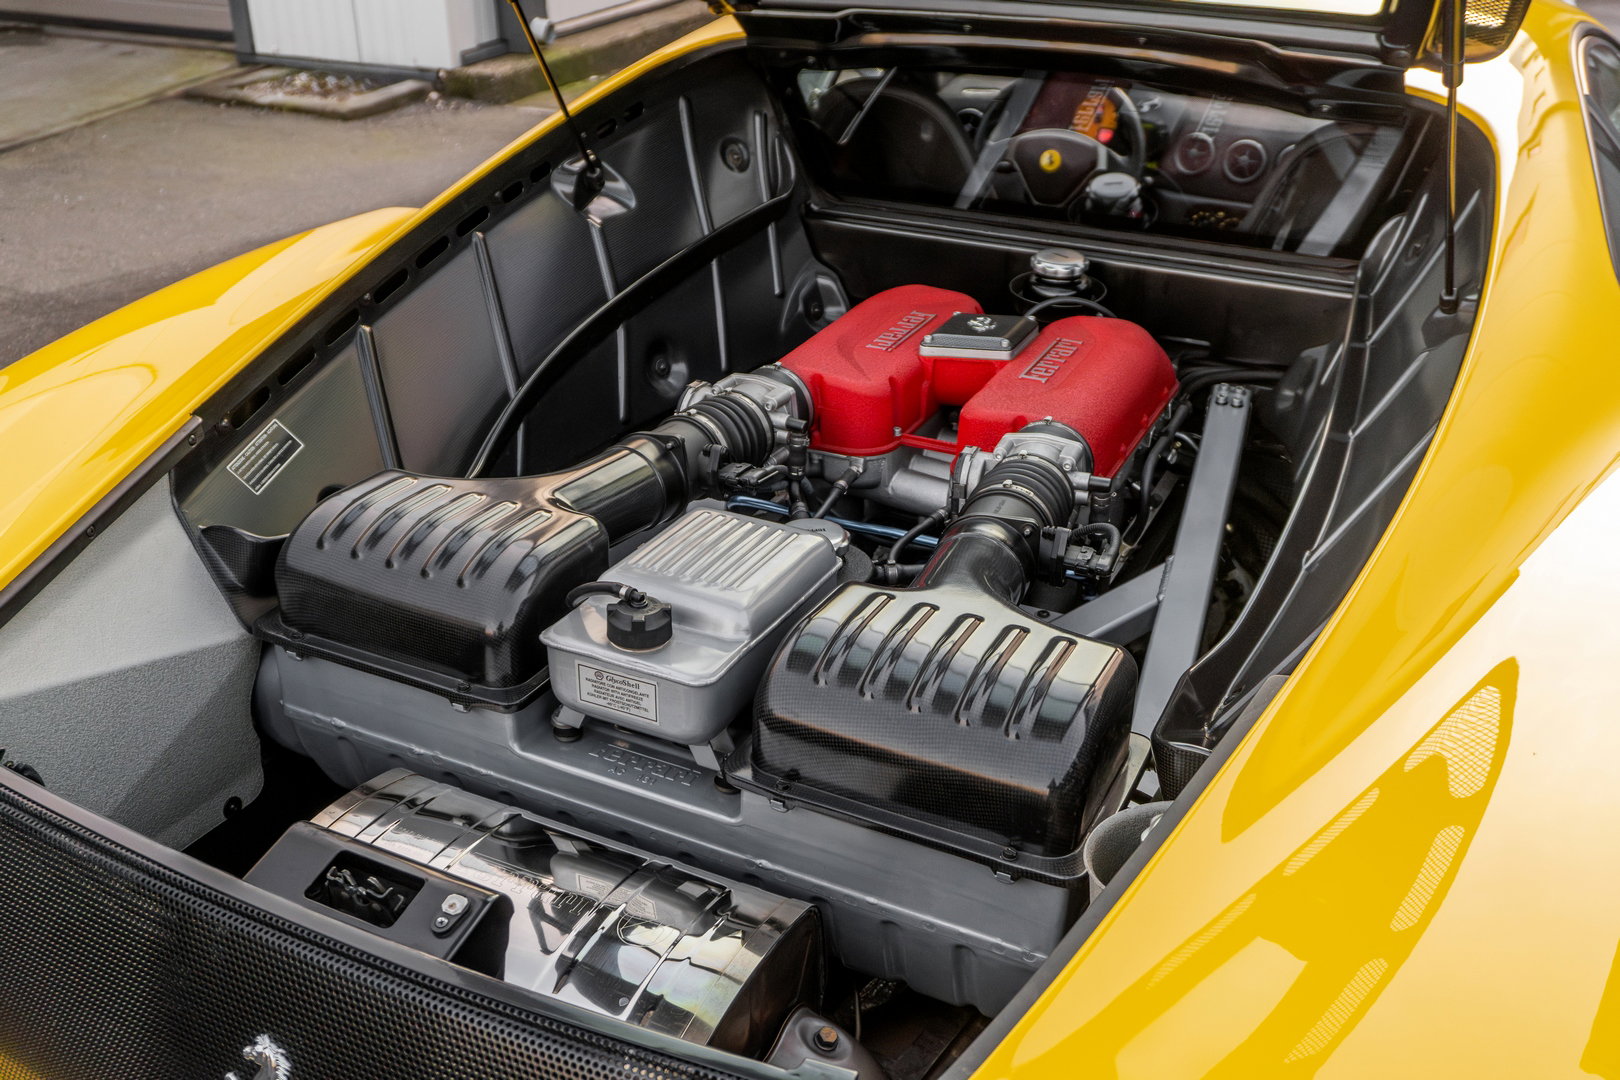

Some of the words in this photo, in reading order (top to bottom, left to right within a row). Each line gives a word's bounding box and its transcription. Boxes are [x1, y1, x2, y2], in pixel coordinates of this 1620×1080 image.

[865, 309, 938, 352] Ferrari
[1018, 336, 1084, 384] Ferrari
[606, 675, 640, 690] GlycoShell
[588, 743, 702, 786] Ferrari
